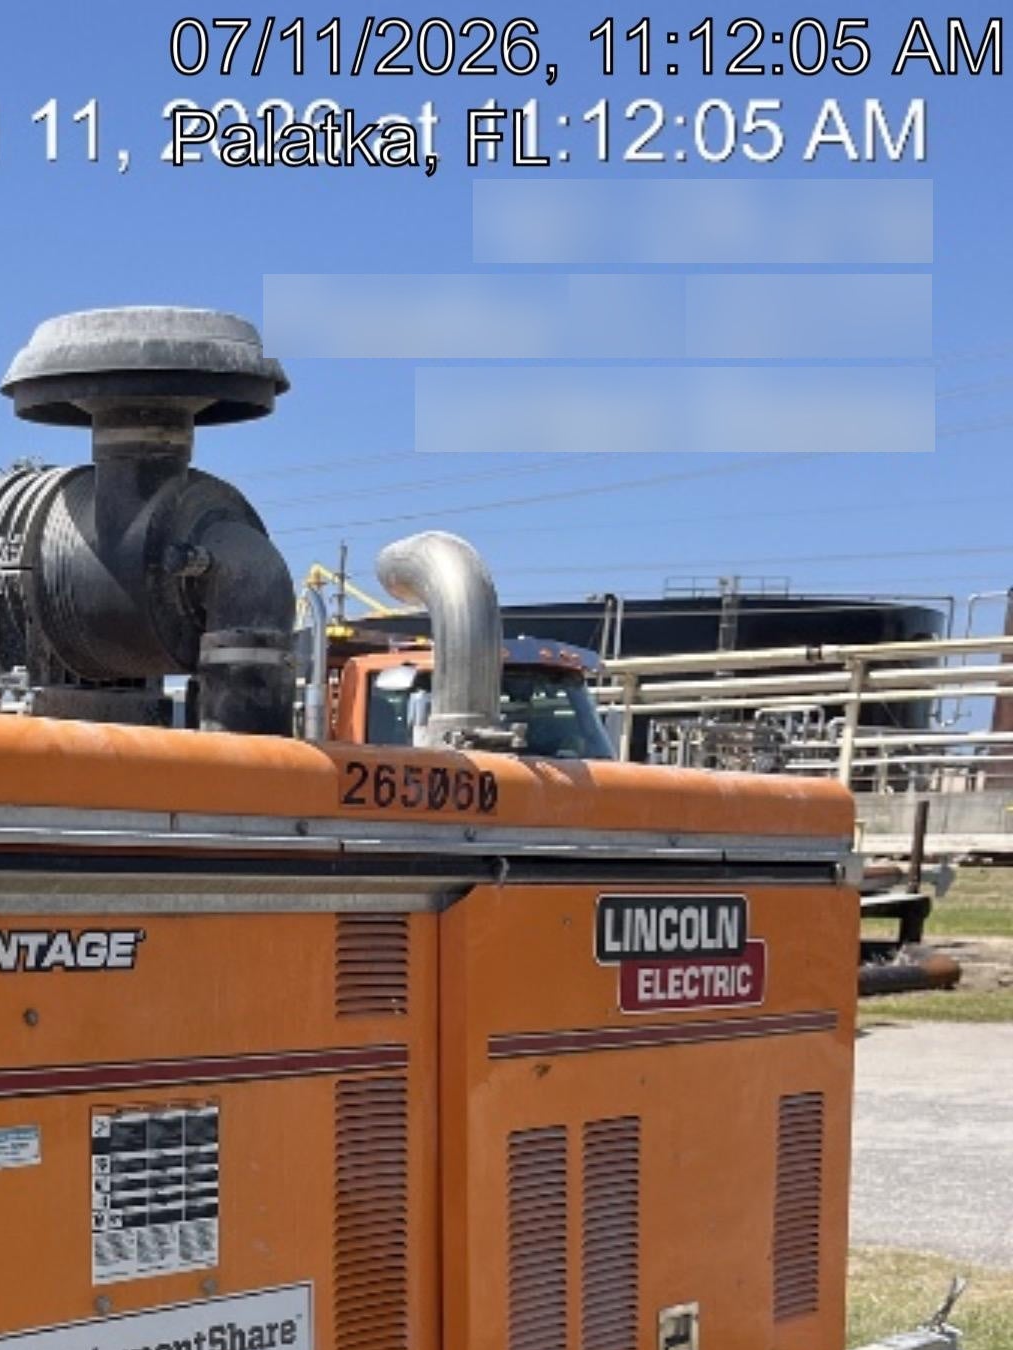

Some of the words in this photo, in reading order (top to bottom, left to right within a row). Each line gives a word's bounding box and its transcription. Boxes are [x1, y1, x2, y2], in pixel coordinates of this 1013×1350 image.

[341, 760, 498, 814] 265060
[603, 904, 740, 953] LINCOLN
[636, 963, 753, 1003] ELECTRIC
